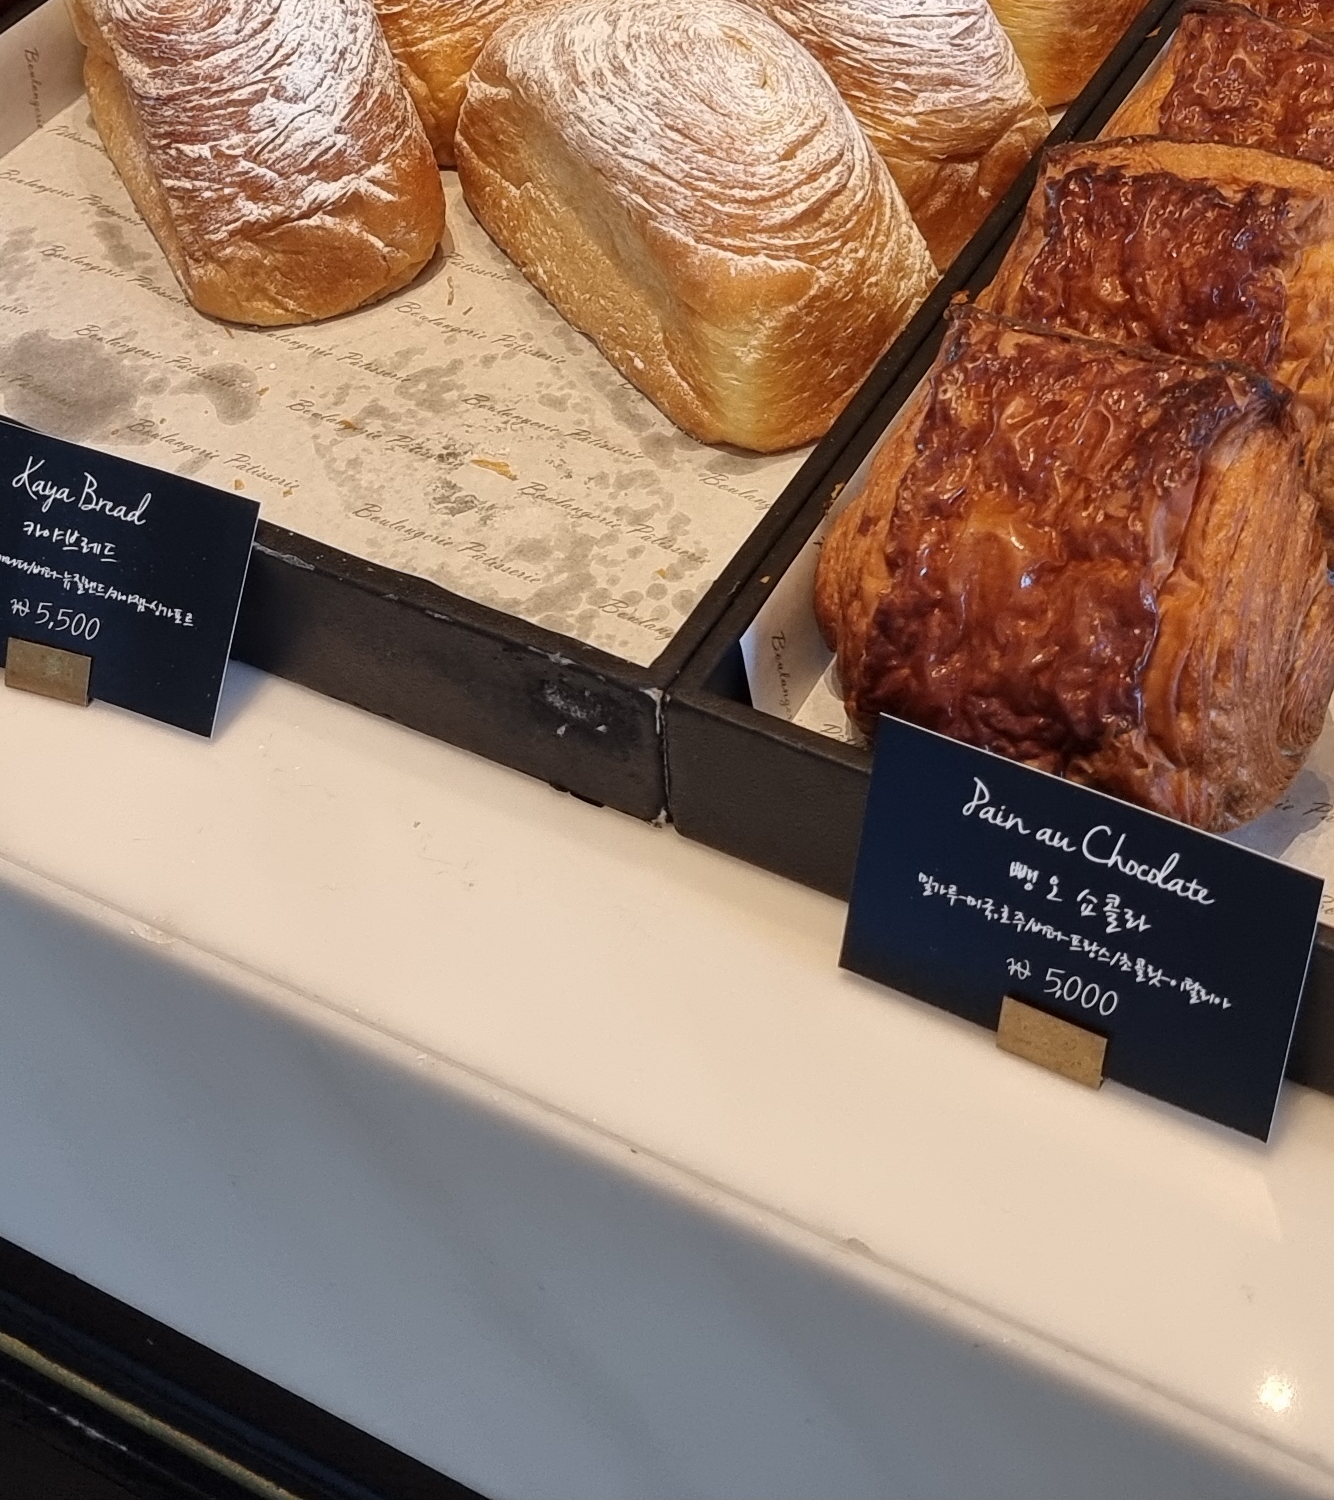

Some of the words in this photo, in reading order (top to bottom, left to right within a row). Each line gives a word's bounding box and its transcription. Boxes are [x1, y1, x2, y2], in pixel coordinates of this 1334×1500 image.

[12, 456, 75, 513] Kaya
[78, 472, 152, 525] Bread
[352, 503, 454, 548] Boulangerie
[962, 776, 1031, 835] Pain
[1036, 826, 1077, 852] au
[1082, 826, 1215, 905] Chocolate
